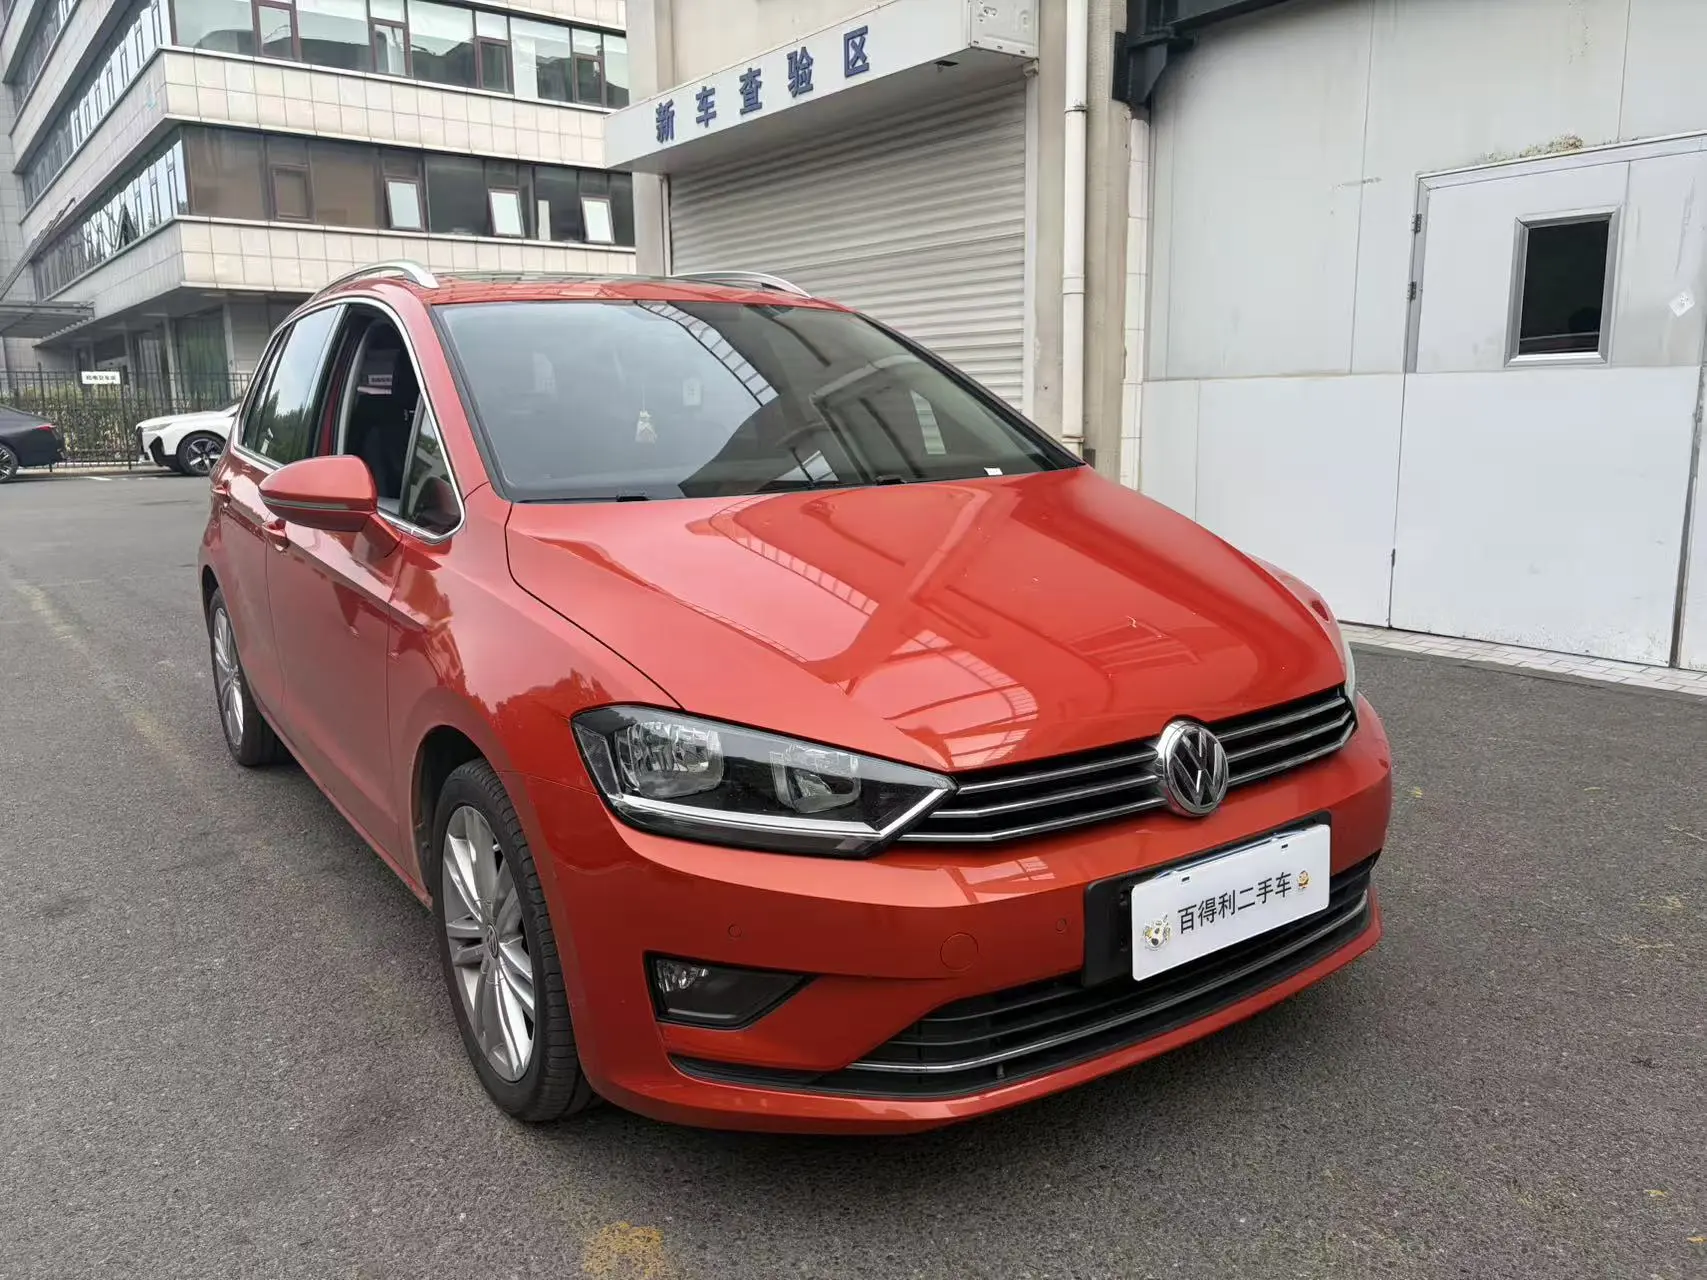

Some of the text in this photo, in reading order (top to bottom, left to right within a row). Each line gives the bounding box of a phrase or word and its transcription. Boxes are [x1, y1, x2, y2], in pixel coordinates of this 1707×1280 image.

[655, 25, 870, 143] 新车查验区
[1167, 725, 1226, 810] VW
[1177, 871, 1292, 934] 百得利二手车
